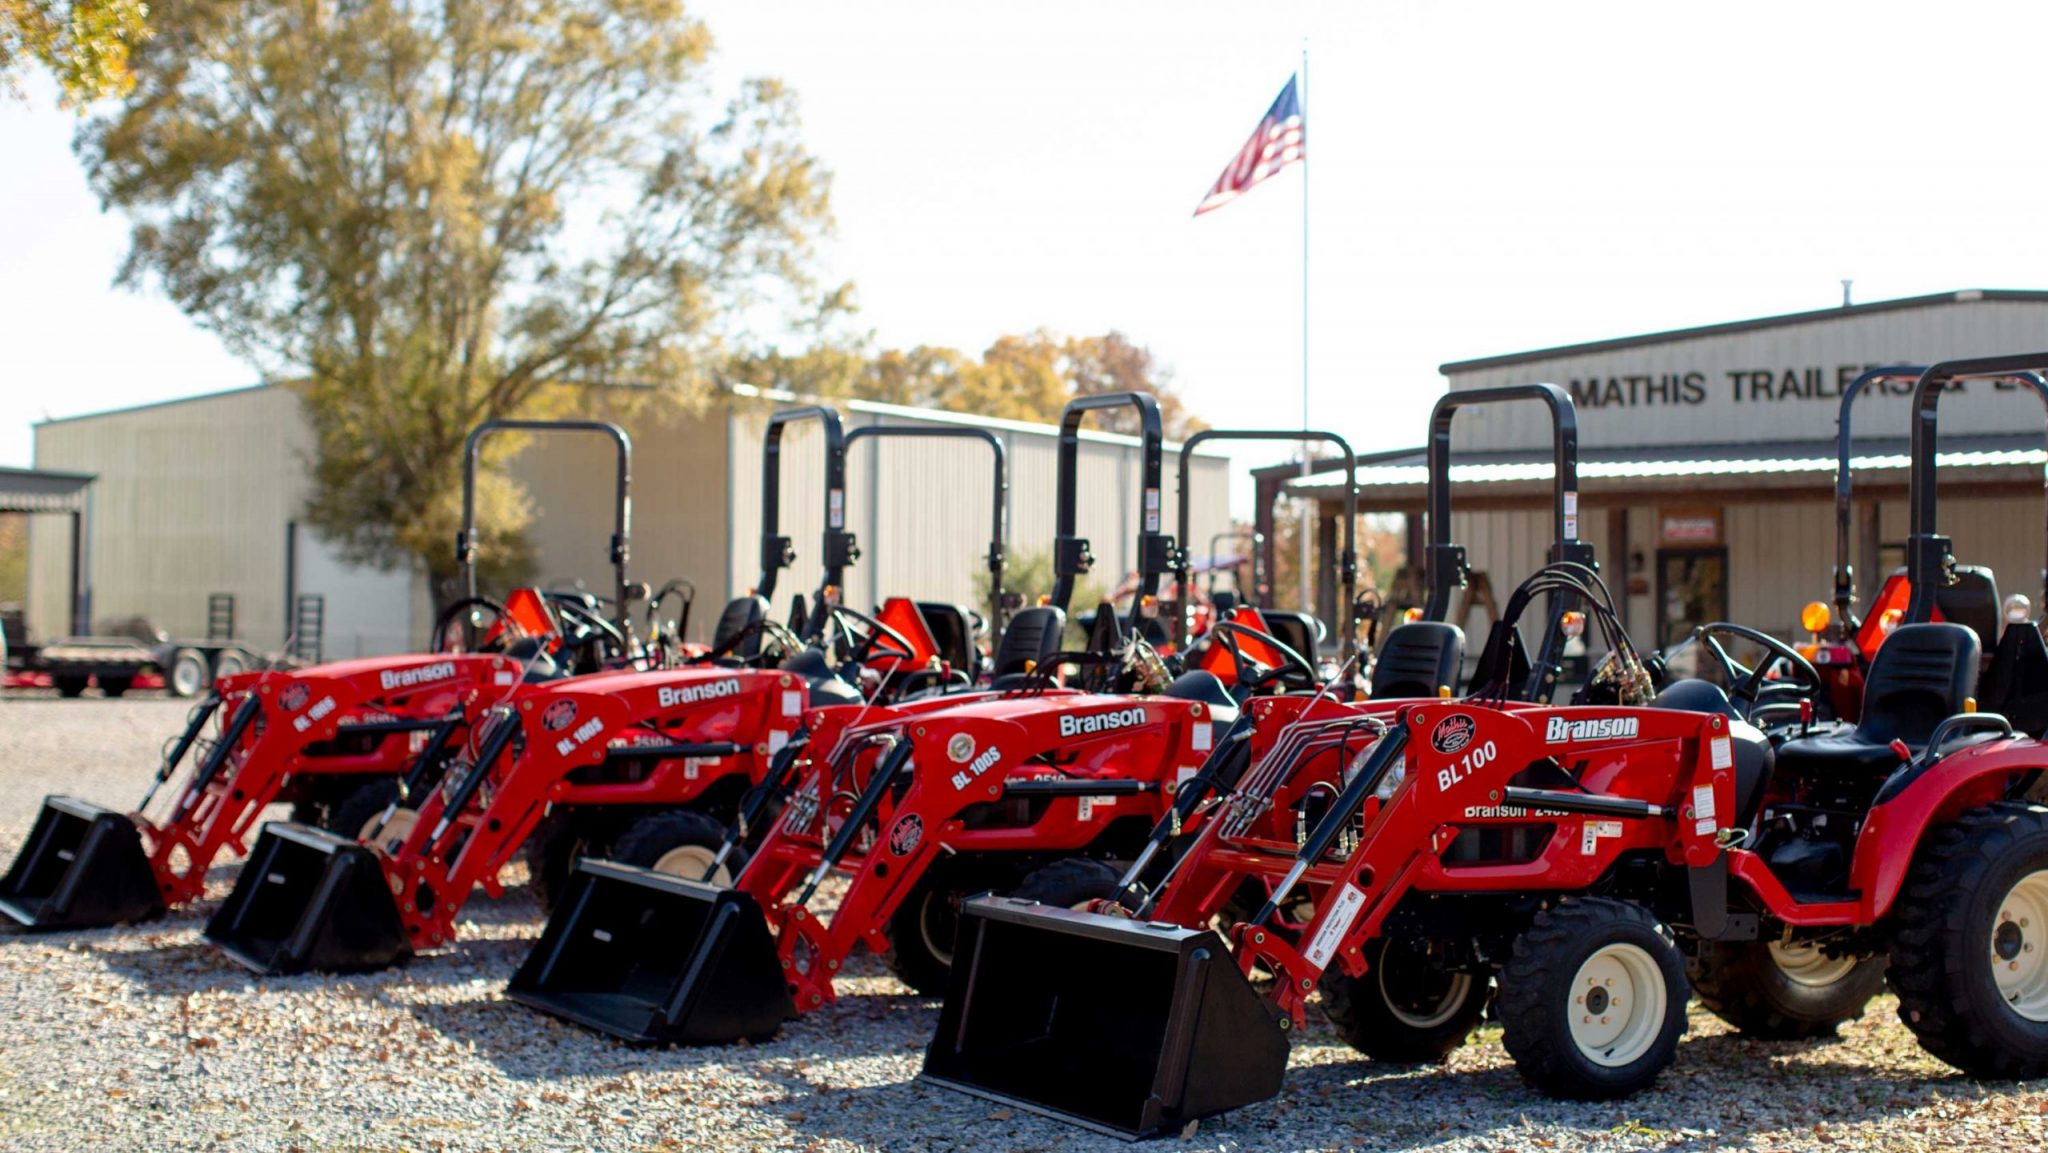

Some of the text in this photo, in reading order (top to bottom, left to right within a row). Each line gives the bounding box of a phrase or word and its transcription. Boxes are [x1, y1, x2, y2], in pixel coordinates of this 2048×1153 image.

[1570, 372, 1706, 408] MATHIS
[380, 661, 455, 690] Branson
[658, 678, 741, 708] Branson
[572, 716, 604, 745] 100S
[1058, 706, 1148, 737] Branson
[1546, 716, 1639, 743] Branson
[951, 771, 972, 791] BL
[969, 745, 1002, 777] 100S
[1437, 766, 1463, 792] BL
[1461, 740, 1497, 771] 100
[1464, 805, 1526, 818] Branson
